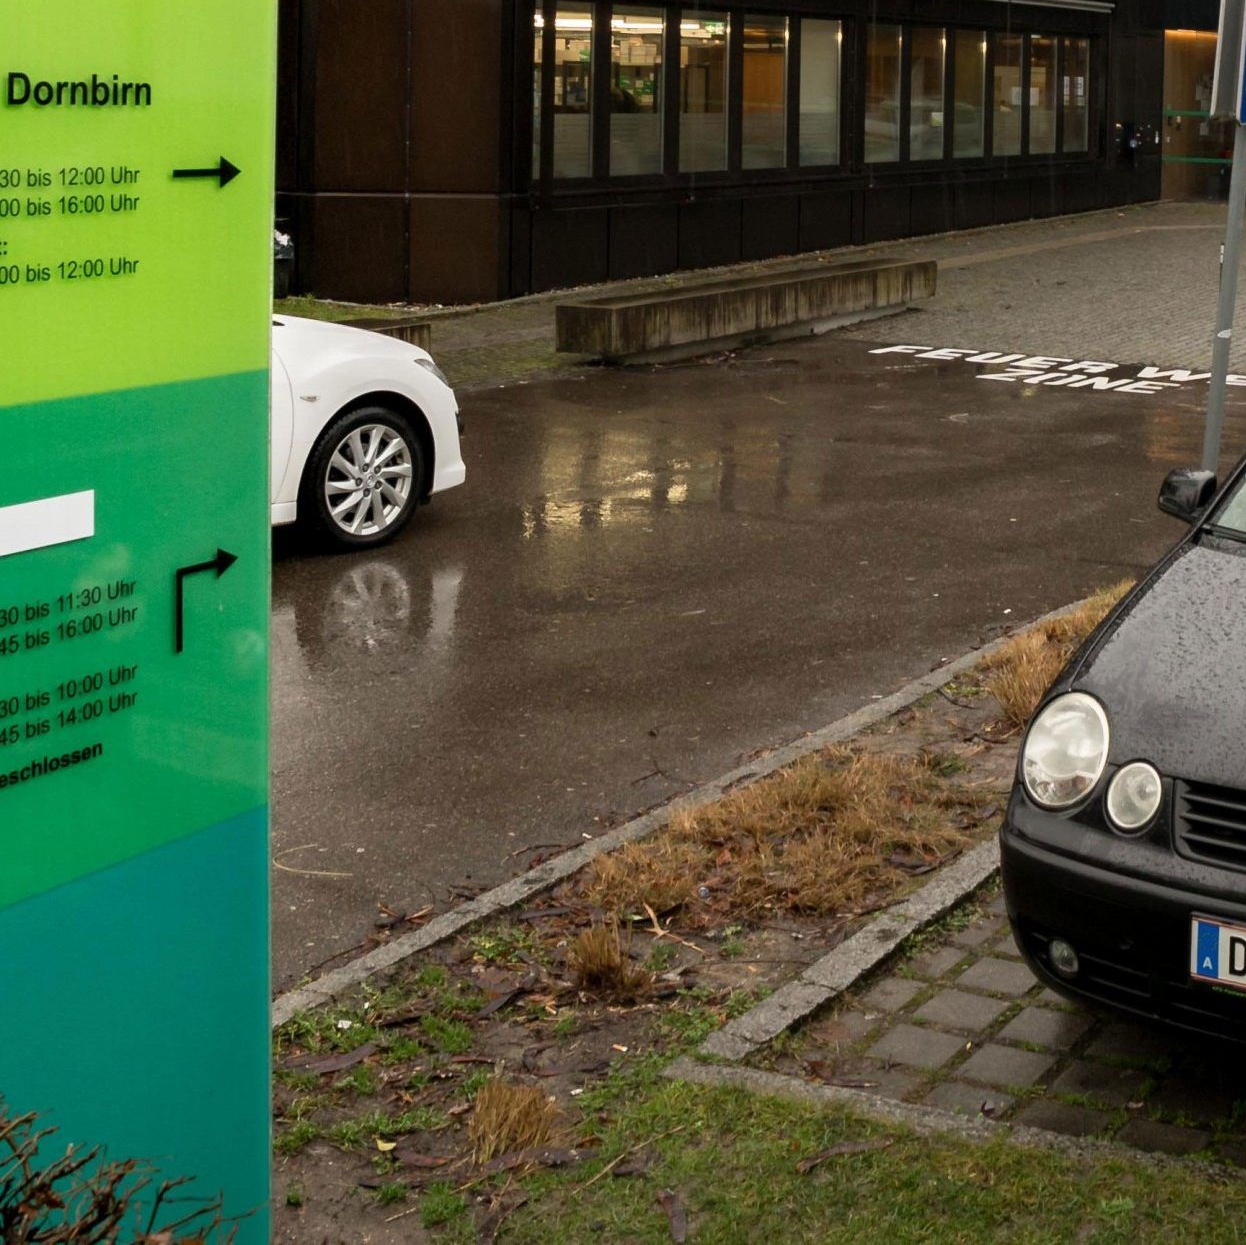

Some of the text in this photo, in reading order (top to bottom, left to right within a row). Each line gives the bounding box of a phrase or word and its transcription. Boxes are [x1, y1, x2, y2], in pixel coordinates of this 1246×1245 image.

[8, 72, 152, 106] Dornbirn
[0, 166, 141, 188] 30 bis 12:00 Uhr
[26, 197, 52, 216] bis
[58, 195, 105, 214] 16:00
[110, 194, 140, 212] Uhr
[26, 263, 51, 283] bis
[57, 259, 104, 279] 12:00
[109, 257, 140, 275] Uhr
[974, 368, 1181, 394] ZONE
[0, 580, 137, 628] 30 bis 11:30 Uhr
[25, 628, 51, 650] bis
[56, 613, 103, 641] 16:00
[108, 606, 139, 627] Uhr
[0, 665, 139, 718] 30 bis 10:00 Uhr
[25, 718, 51, 739] bis
[56, 699, 103, 729] 14:00
[108, 692, 139, 713] Uhr
[0, 742, 104, 789] eschlossen
[1202, 957, 1213, 970] A
